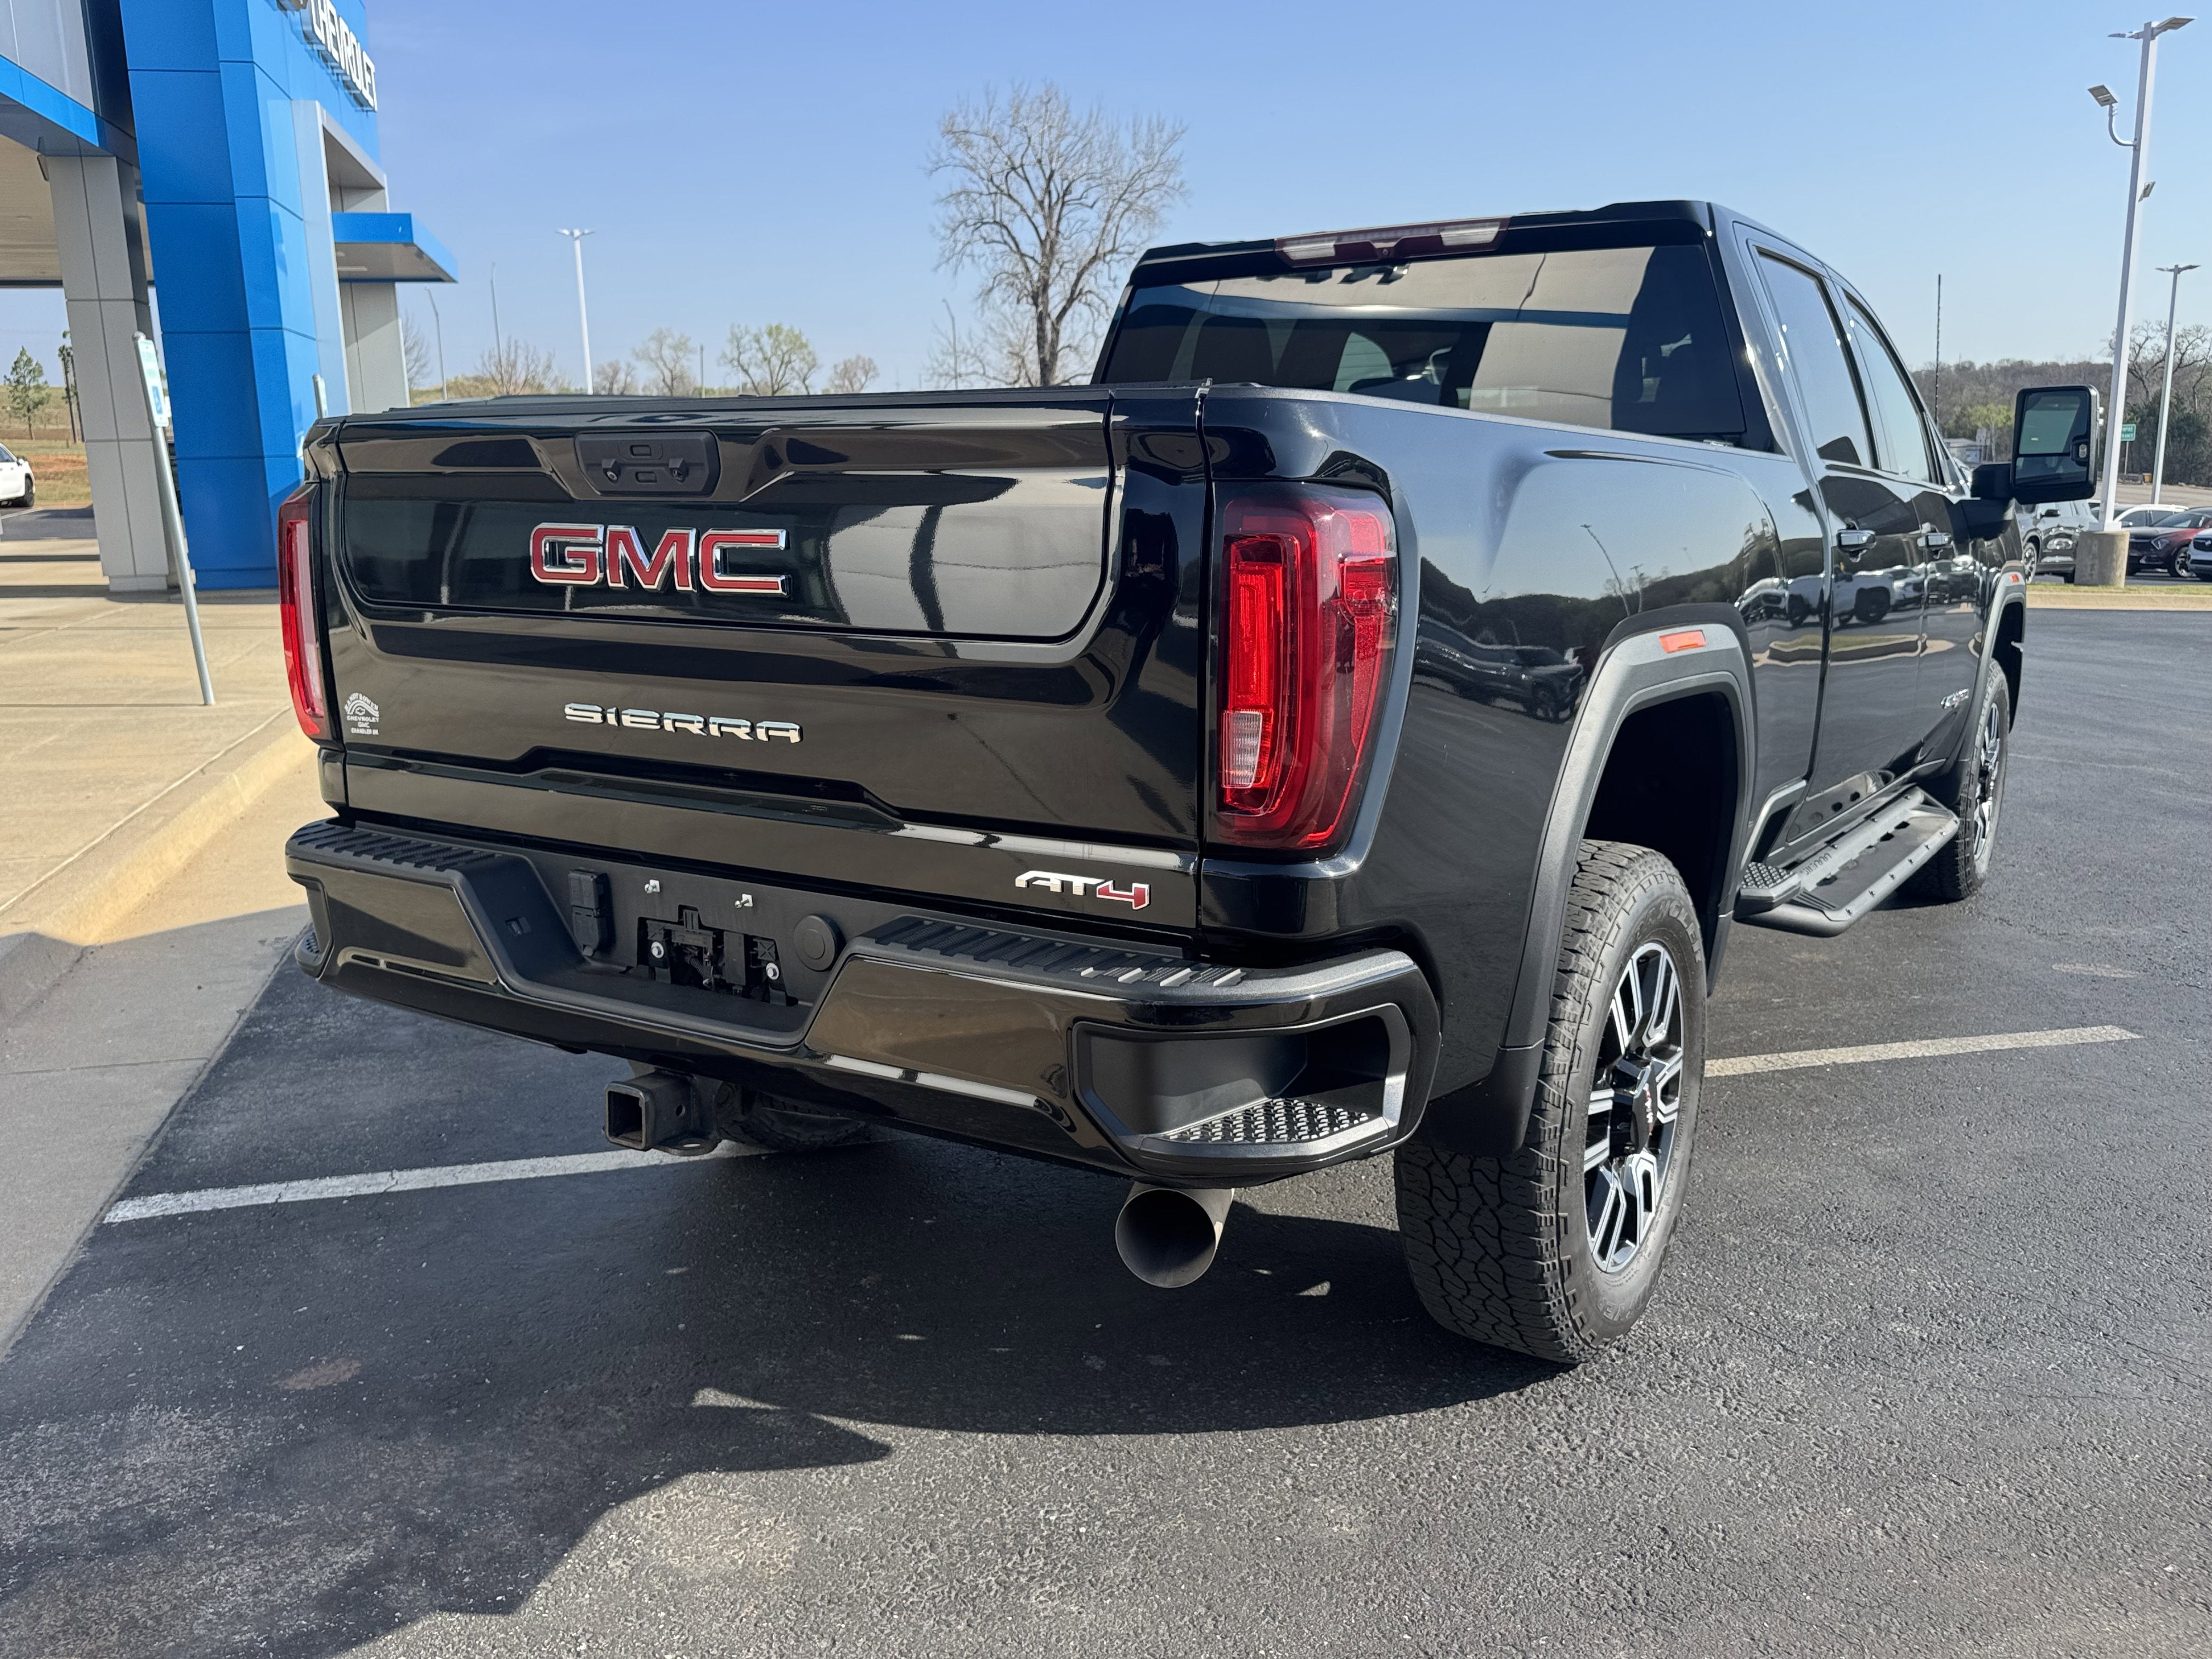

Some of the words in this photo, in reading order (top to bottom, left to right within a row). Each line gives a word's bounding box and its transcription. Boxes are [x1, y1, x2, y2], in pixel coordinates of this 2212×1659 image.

[530, 523, 791, 596] GMC
[564, 702, 802, 743] SIERRA
[1015, 870, 1150, 911] AT4
